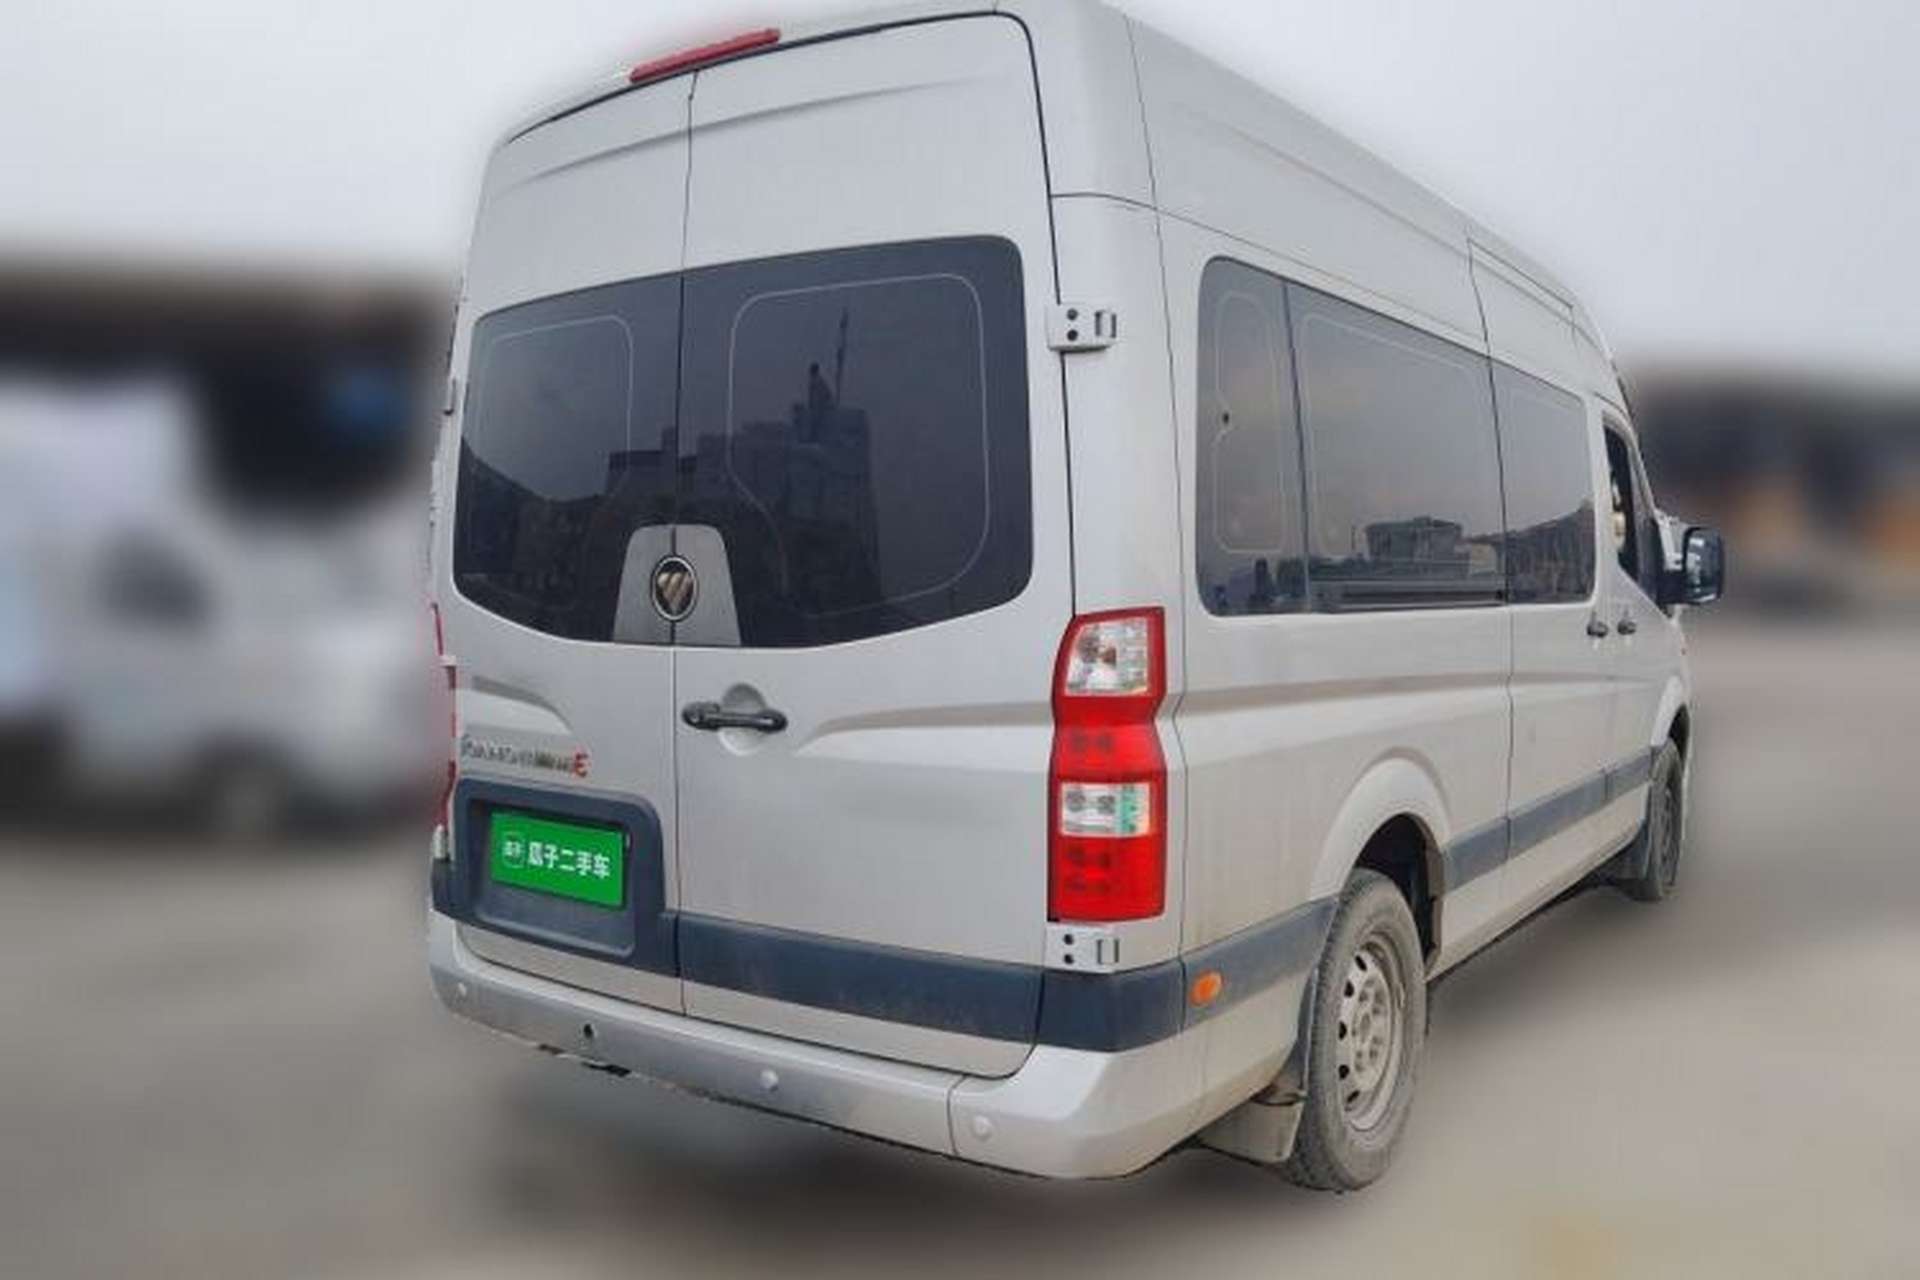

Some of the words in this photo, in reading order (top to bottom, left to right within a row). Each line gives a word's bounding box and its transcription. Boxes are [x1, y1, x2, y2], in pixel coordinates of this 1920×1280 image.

[527, 840, 612, 880] 瓜子二手车
